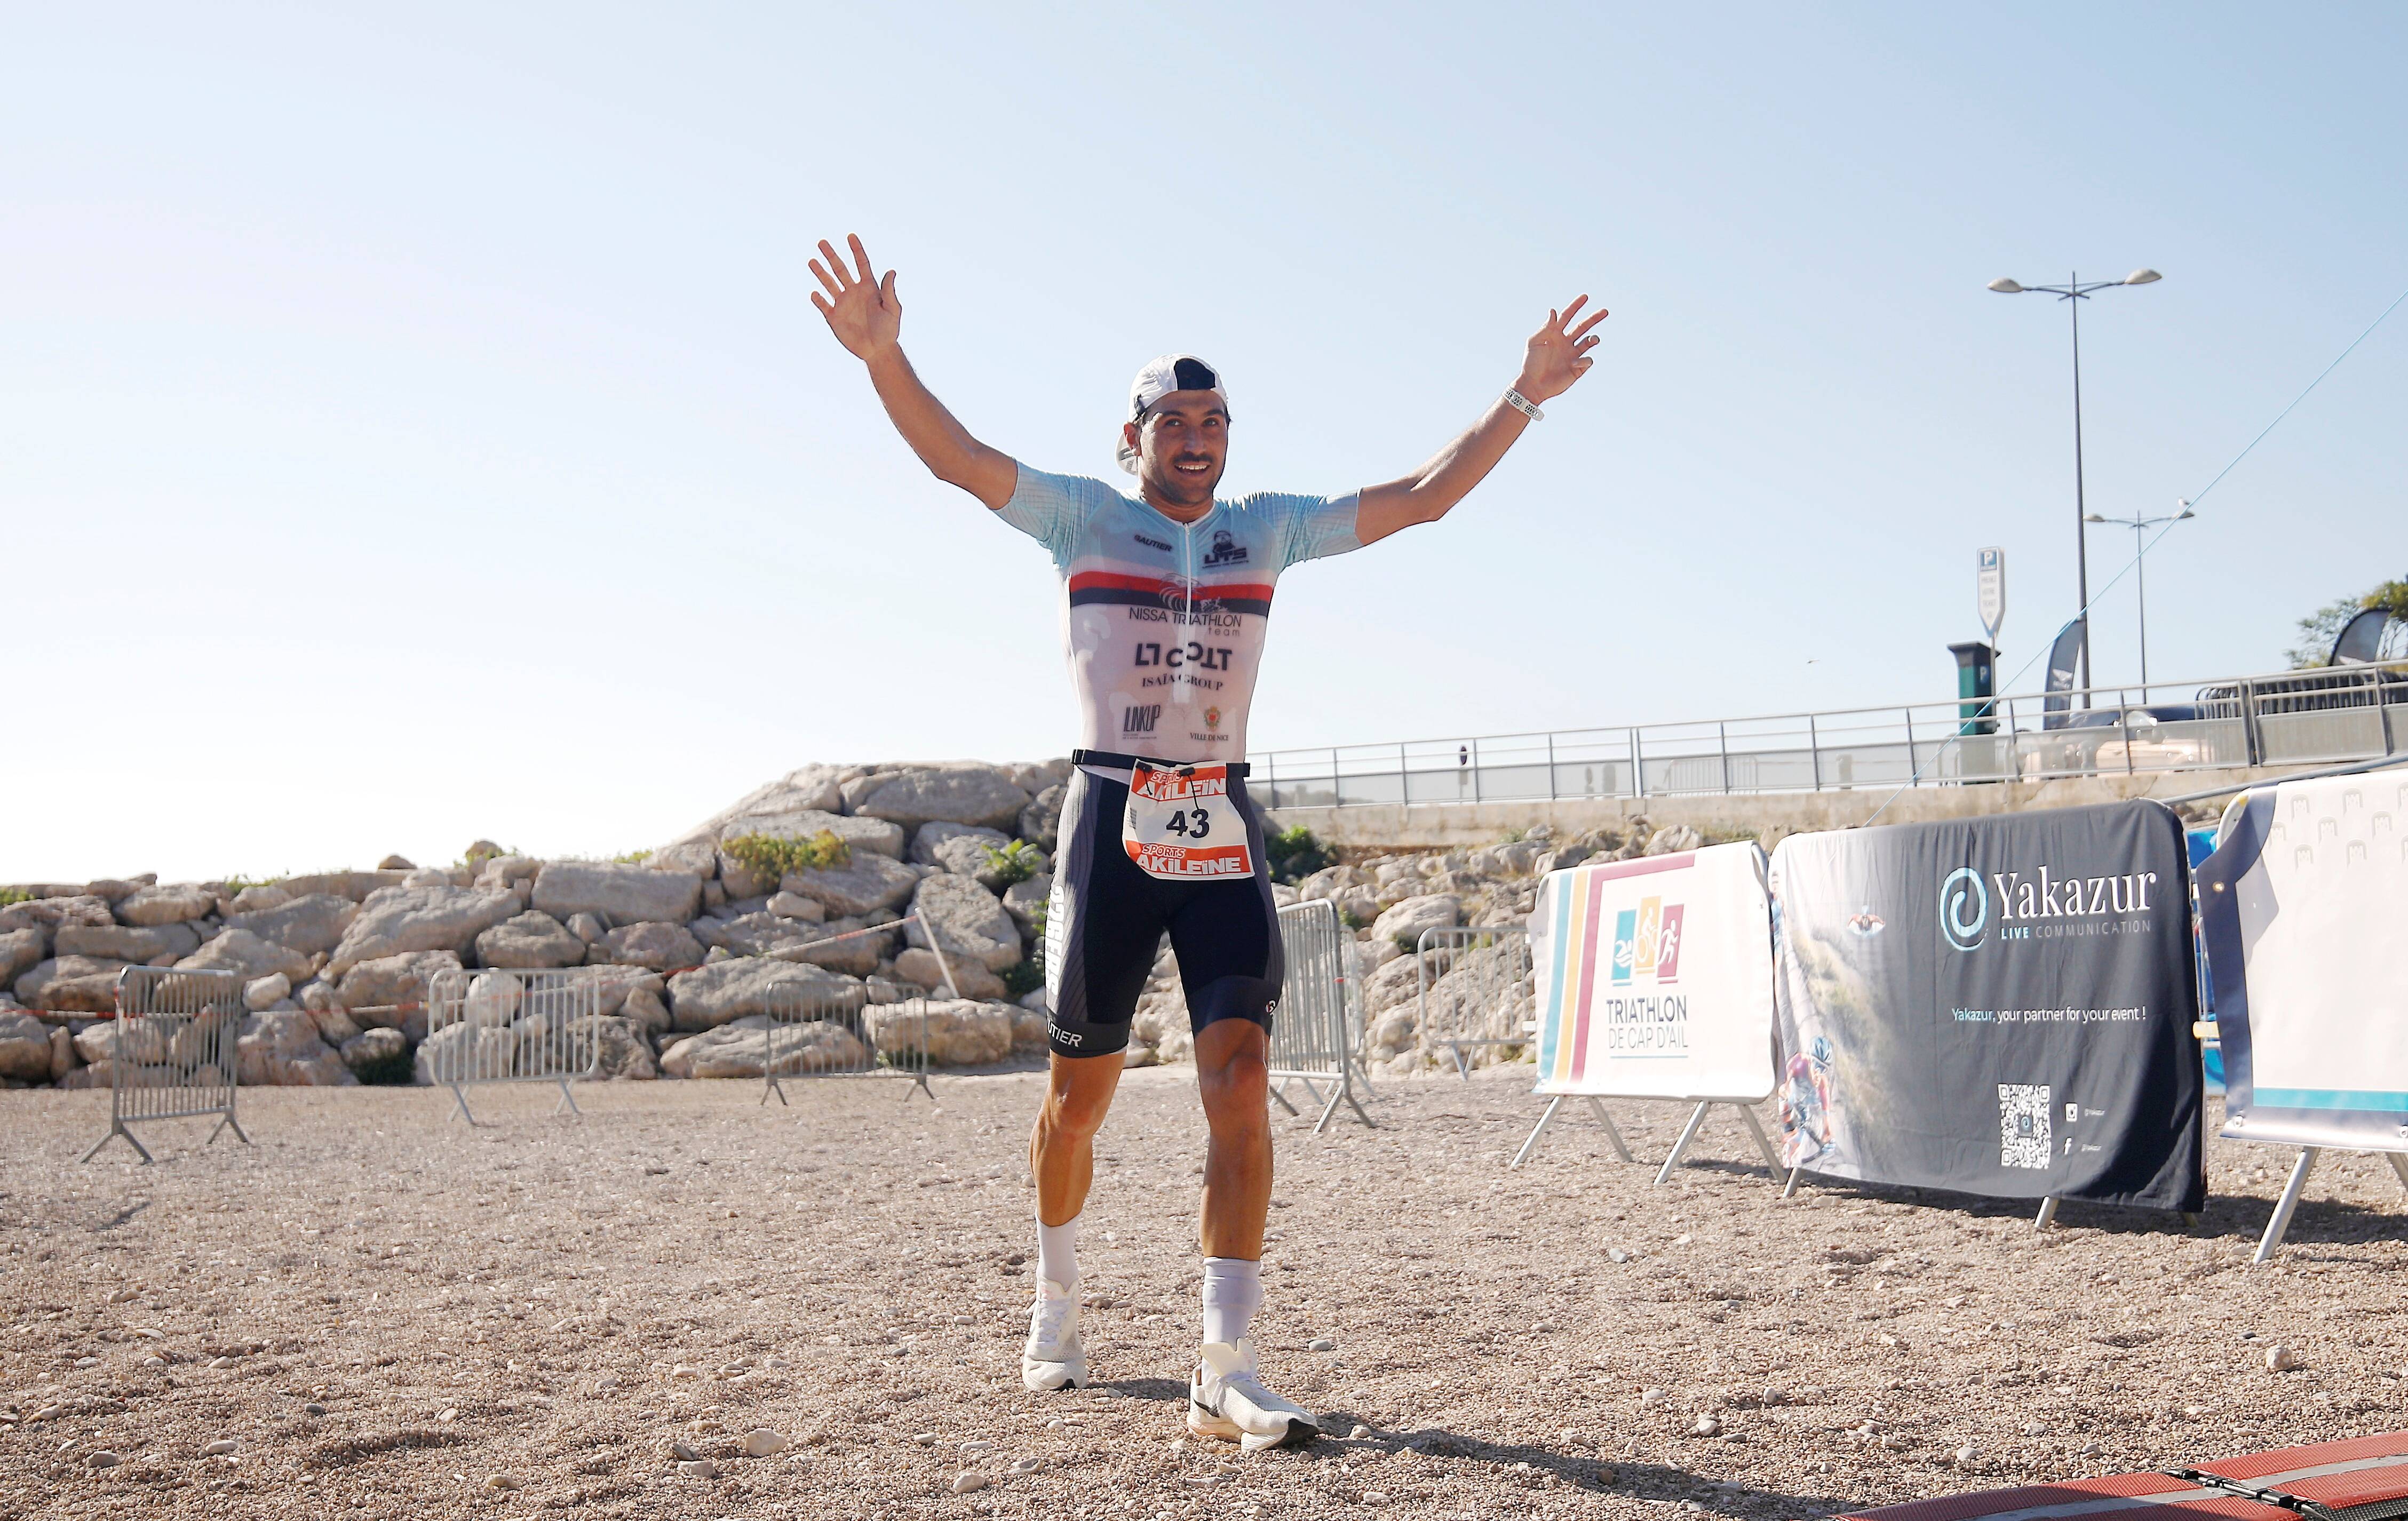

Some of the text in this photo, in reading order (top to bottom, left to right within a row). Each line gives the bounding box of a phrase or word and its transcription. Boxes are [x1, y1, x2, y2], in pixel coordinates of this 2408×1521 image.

[1134, 535, 1172, 552] GAUTIER
[1984, 551, 1992, 565] P
[1130, 607, 1242, 627] NISSA TRIATHLON
[1209, 627, 1240, 637] team
[1142, 673, 1223, 690] ISAÏA GROUP
[1190, 732, 1206, 740] VILLE
[1166, 809, 1209, 838] 43
[1142, 844, 1186, 858] SPORTS
[1993, 864, 2157, 920] Yakazur
[2001, 920, 2150, 939] LIVE COMMUNICATION
[1606, 995, 1687, 1024] TRIATHLON
[1951, 1007, 1996, 1022] Yakazur,
[1997, 1009, 2021, 1024] your
[2023, 1008, 2065, 1024] partner
[2065, 1006, 2080, 1020] for
[2082, 1008, 2110, 1024] your
[2111, 1007, 2140, 1021] event
[1048, 1018, 1082, 1047] UTIER
[1608, 1025, 1688, 1049] DE CAP D'AIL
